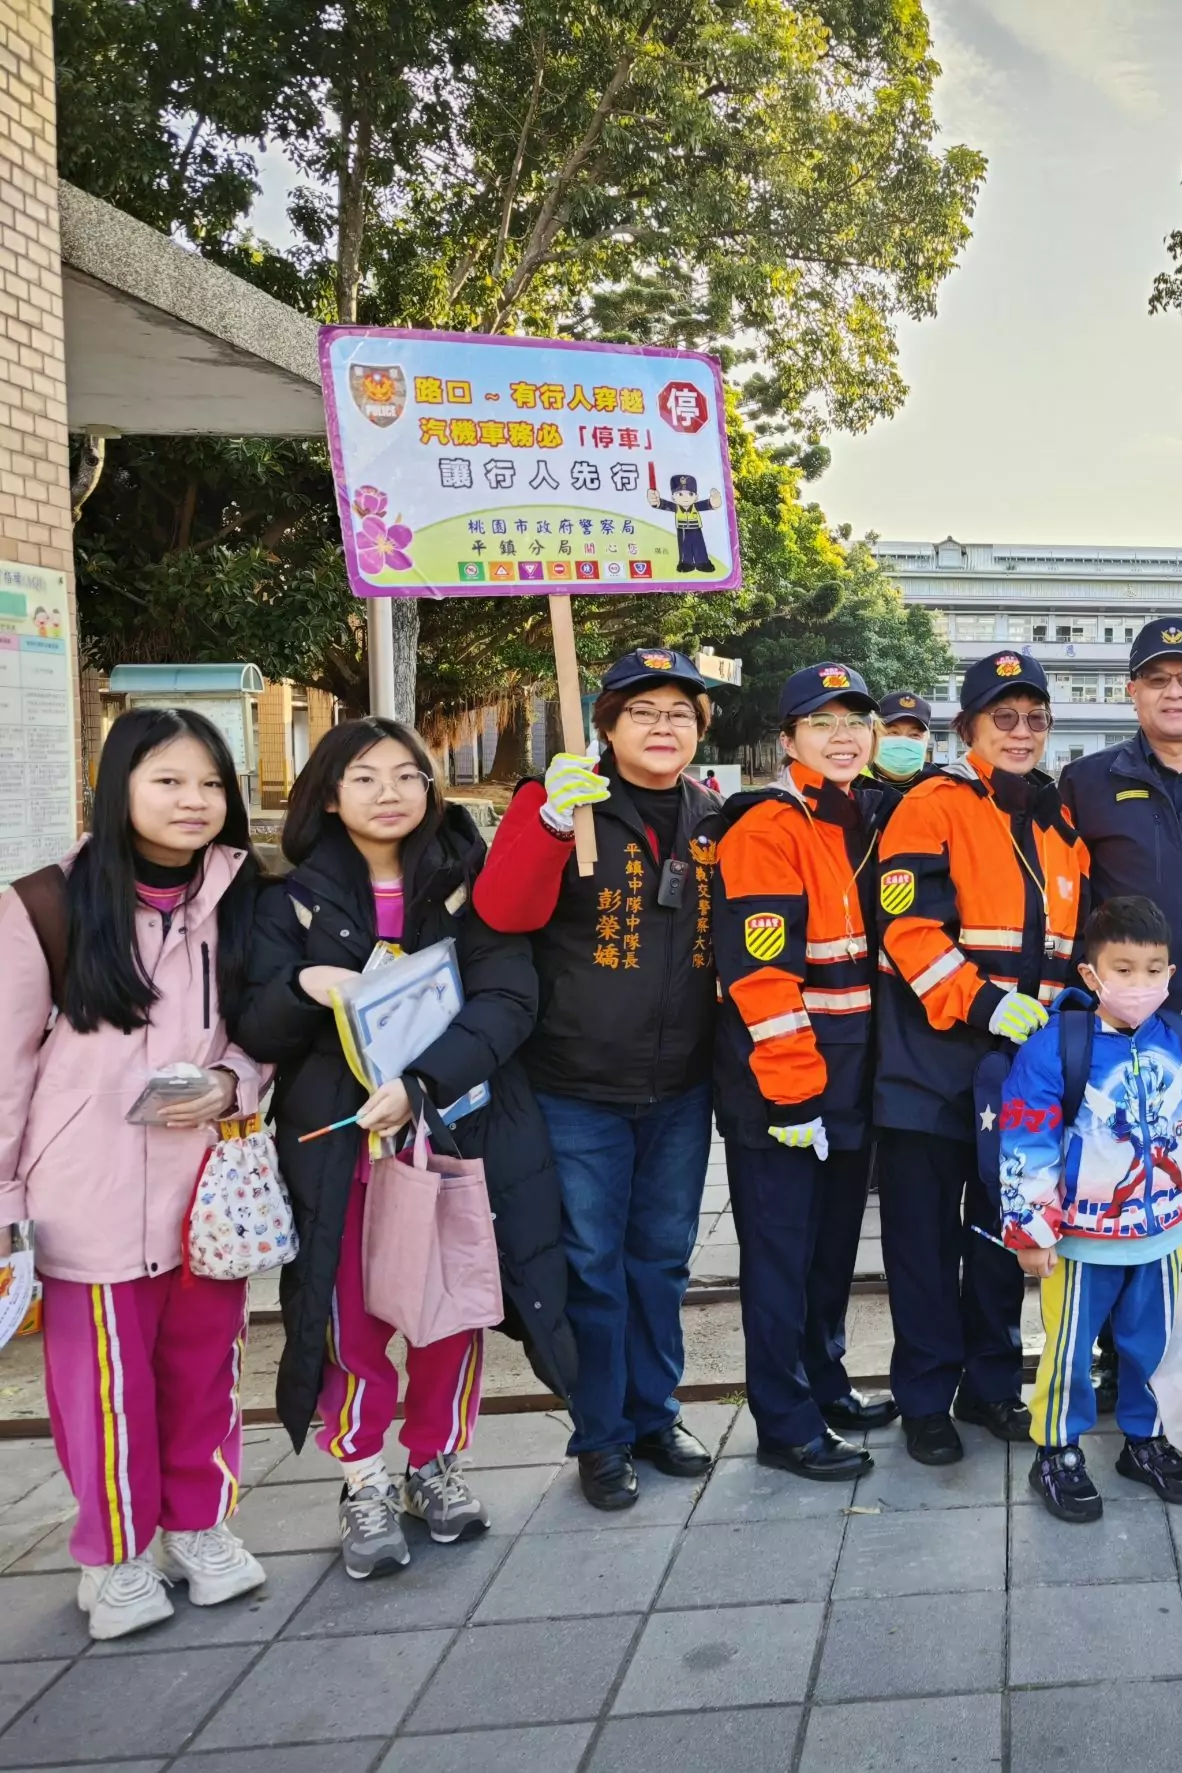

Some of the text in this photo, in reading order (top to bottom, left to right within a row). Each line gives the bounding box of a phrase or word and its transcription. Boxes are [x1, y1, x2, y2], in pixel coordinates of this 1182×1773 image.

[667, 388, 700, 427] 停
[438, 458, 640, 491] 讓行人先行
[468, 519, 636, 536] 桃園市政府警察局
[622, 843, 645, 970] 平鎮中隊中隊長
[592, 887, 623, 970] 彭榮嬌
